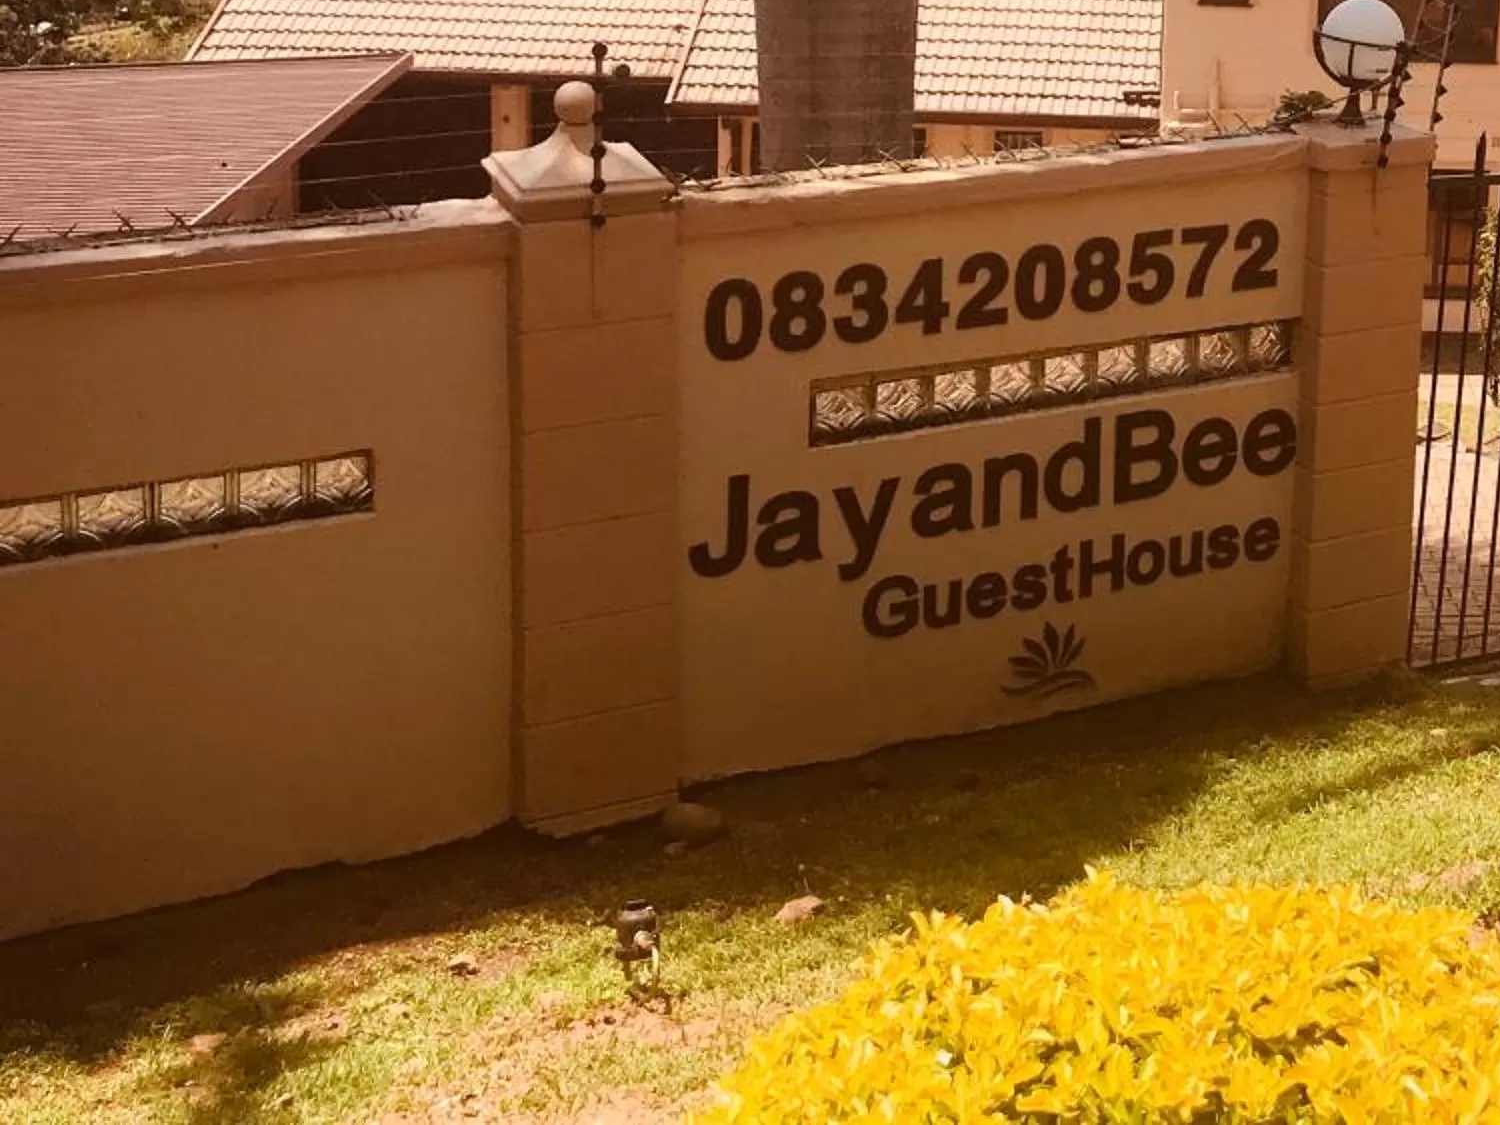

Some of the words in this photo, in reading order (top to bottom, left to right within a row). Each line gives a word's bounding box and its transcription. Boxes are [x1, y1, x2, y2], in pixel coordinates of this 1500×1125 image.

[704, 218, 1279, 362] 0834208572
[688, 408, 1297, 582] JayandBee
[862, 517, 1281, 638] GuestHouse
